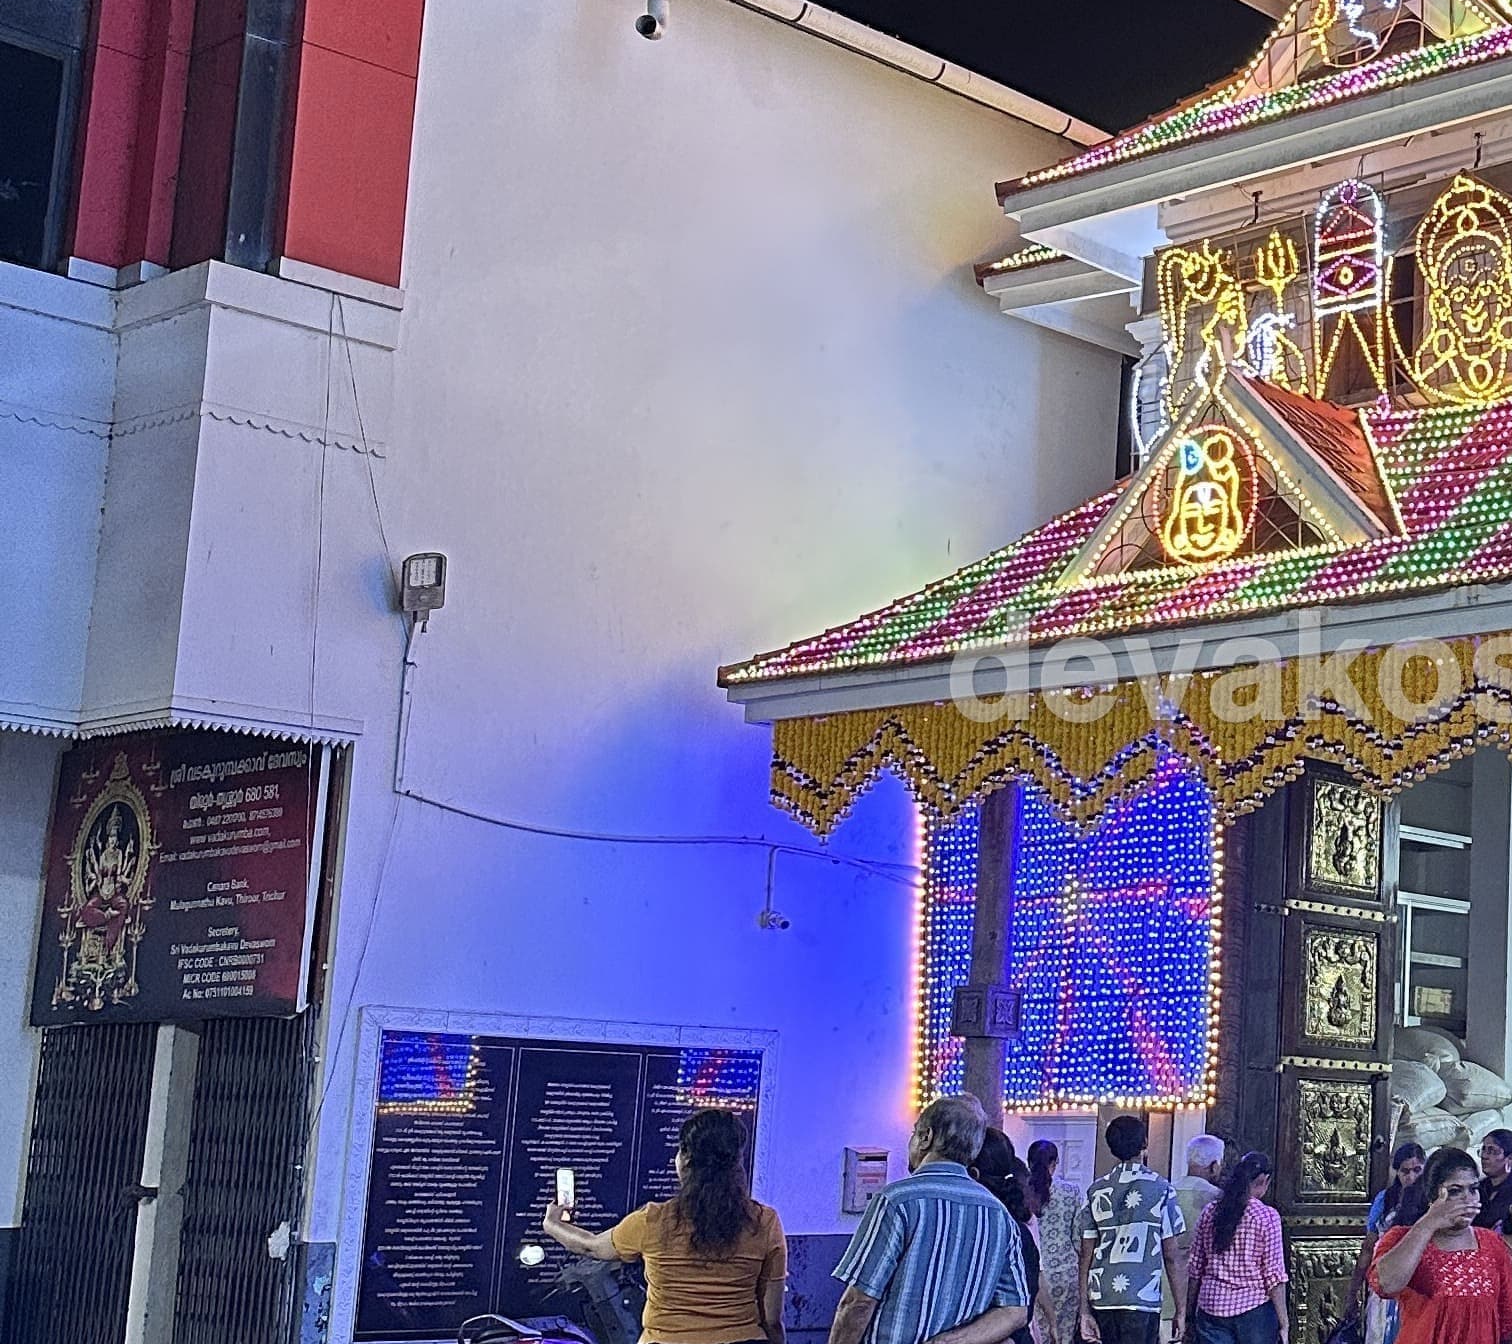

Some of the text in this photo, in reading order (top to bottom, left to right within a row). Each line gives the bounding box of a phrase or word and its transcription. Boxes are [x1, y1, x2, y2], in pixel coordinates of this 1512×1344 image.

[207, 880, 230, 892] Canara
[170, 944, 180, 955] Sri
[177, 958, 194, 970] IFSC
[194, 956, 215, 969] CODE
[183, 973, 201, 984] MICR
[201, 971, 221, 983] CODE
